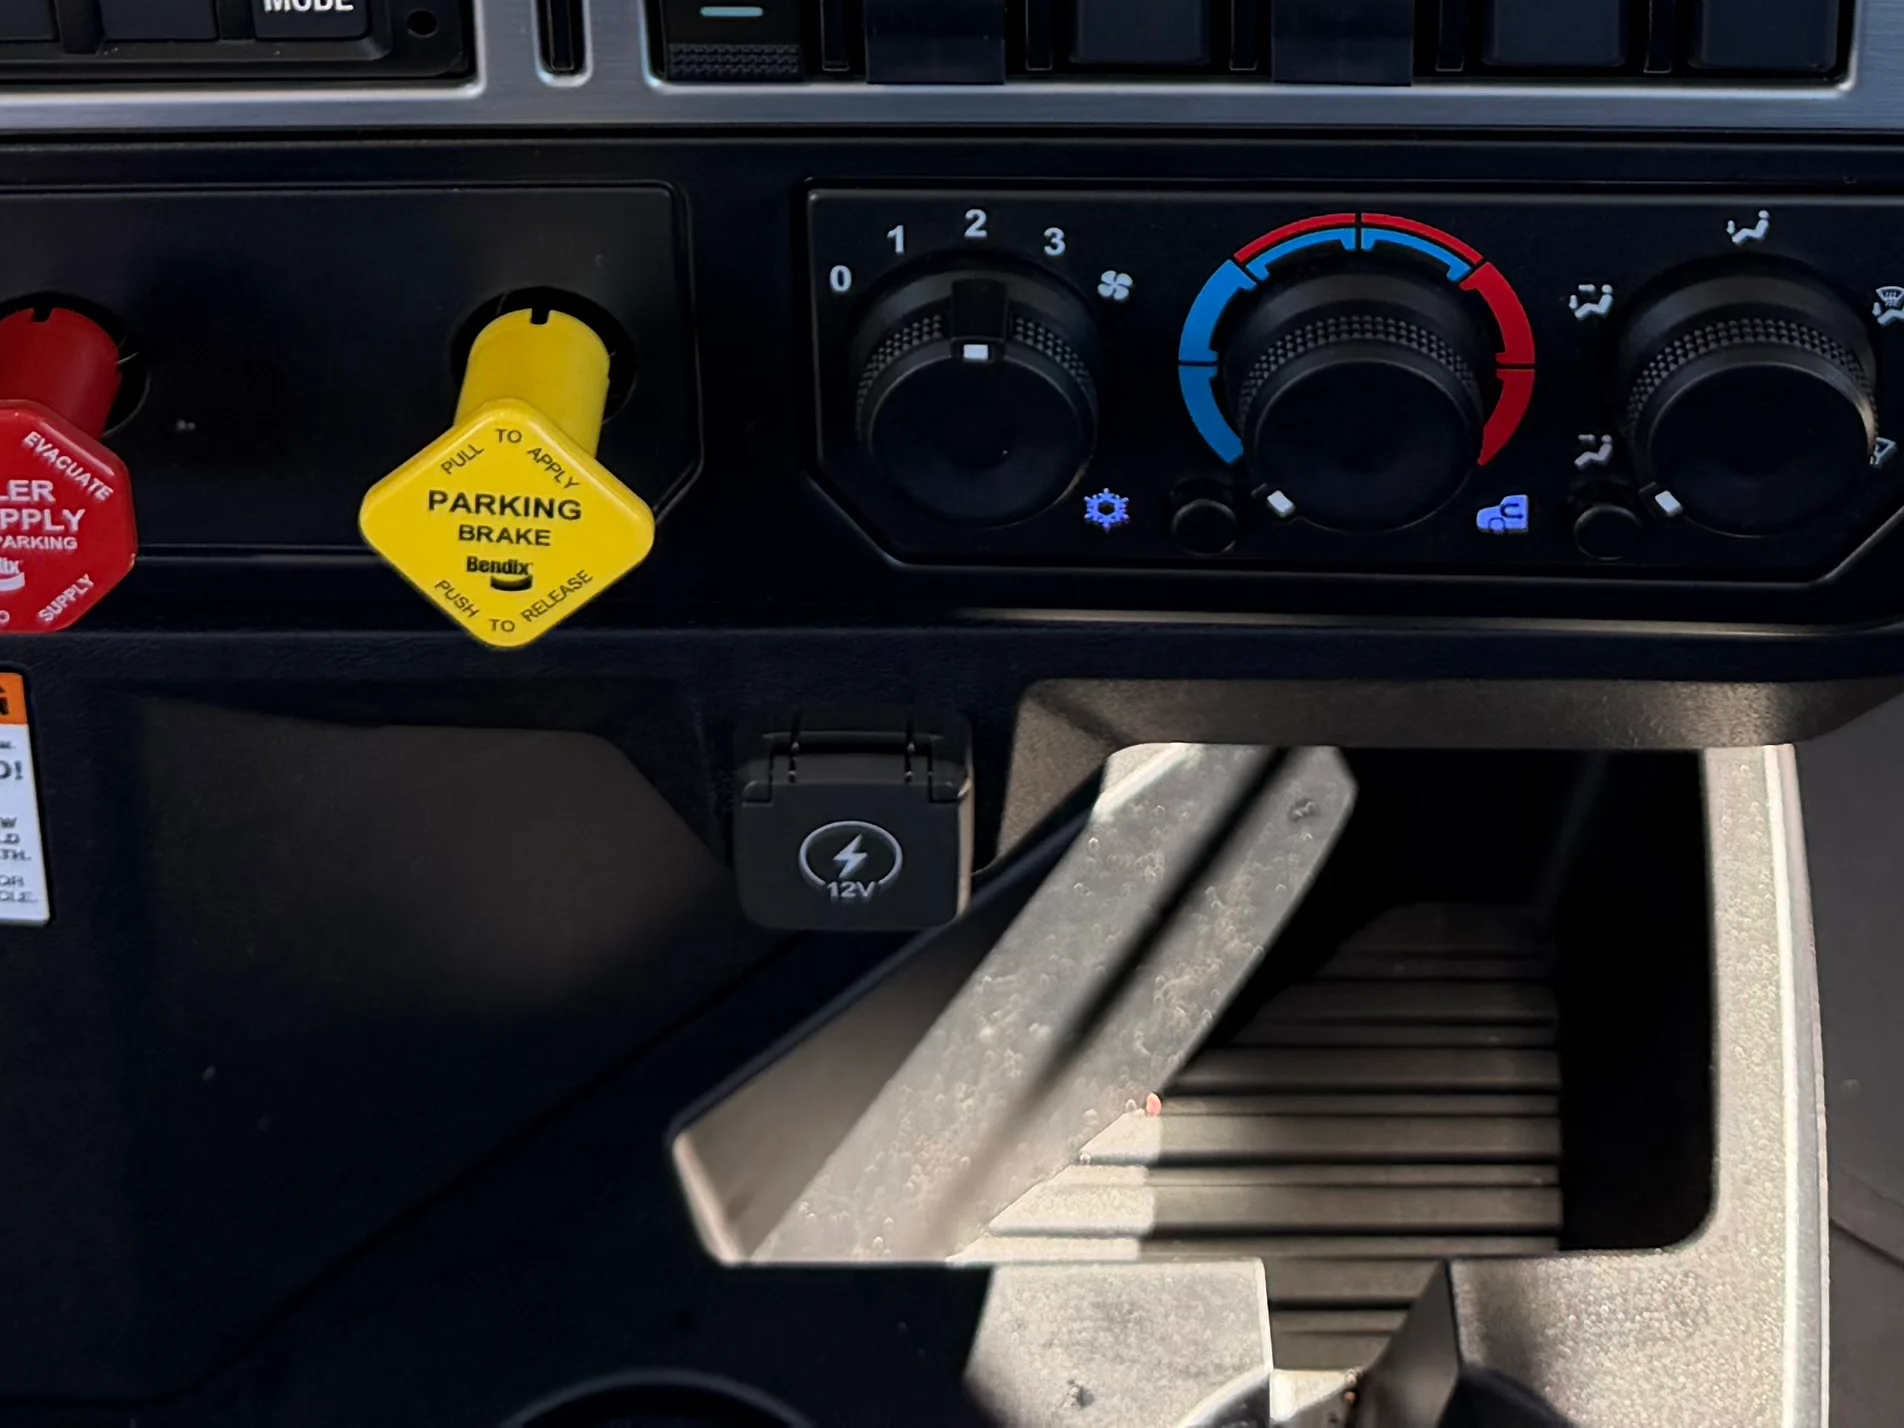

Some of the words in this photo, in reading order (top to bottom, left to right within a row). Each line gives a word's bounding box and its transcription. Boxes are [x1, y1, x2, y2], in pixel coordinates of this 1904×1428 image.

[964, 209, 988, 238] 2
[887, 225, 905, 254] 1
[1043, 227, 1066, 256] 3
[830, 265, 852, 293] 0
[23, 431, 115, 502] EVACUATE
[441, 444, 485, 475] PULL
[495, 428, 522, 444] TO
[527, 446, 581, 490] APPLY
[428, 490, 582, 521] PARKING
[458, 524, 551, 547] BRAKE
[466, 556, 530, 576] Bendix
[37, 573, 95, 622] SUPPLY
[434, 580, 480, 619] PUSH
[489, 619, 515, 633] TO
[521, 570, 593, 623] RELEASE
[826, 881, 876, 898] 12V
